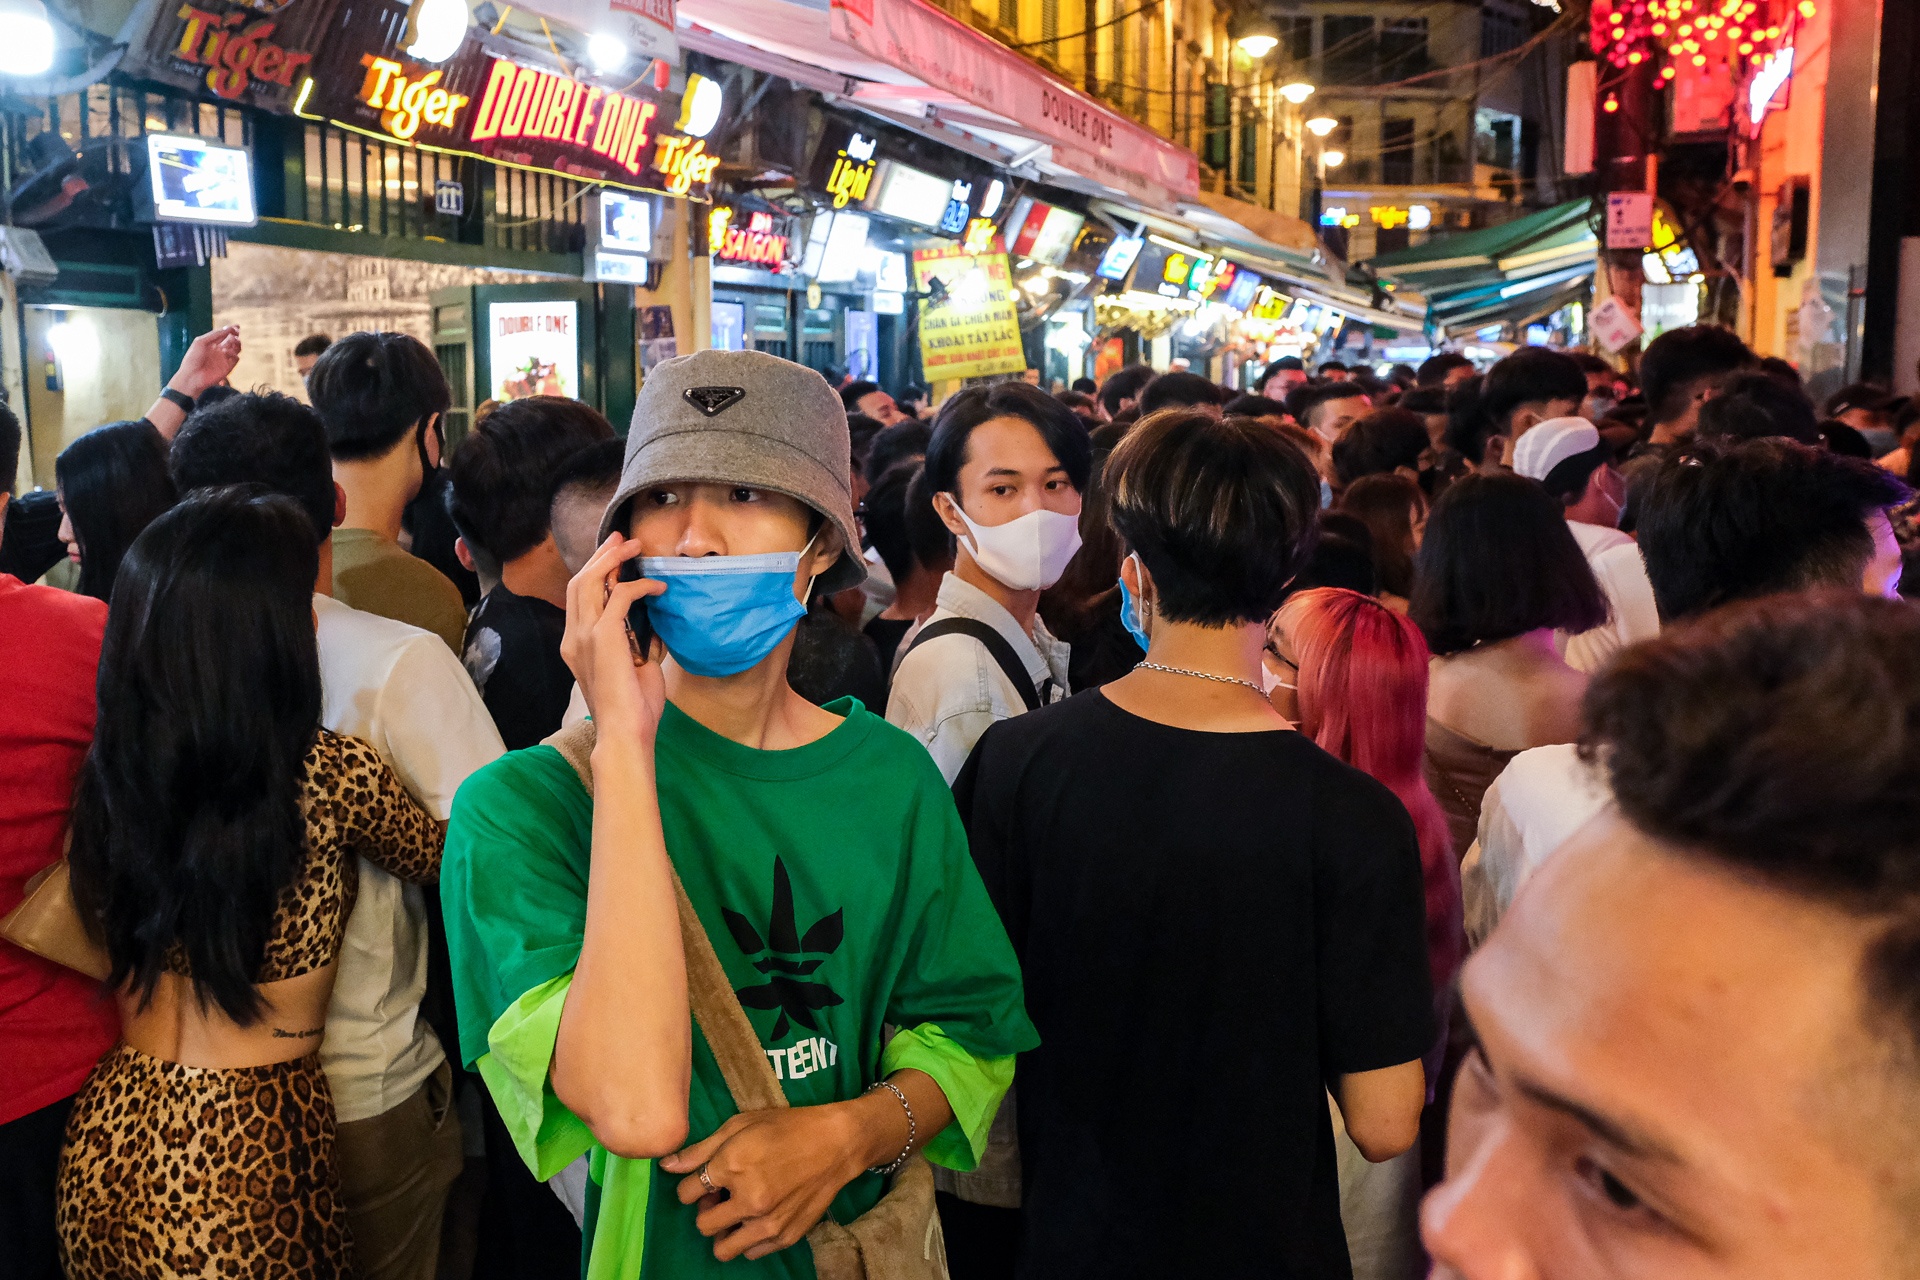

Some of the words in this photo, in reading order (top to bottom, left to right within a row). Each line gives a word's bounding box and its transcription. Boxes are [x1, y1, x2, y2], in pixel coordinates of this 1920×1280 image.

[177, 5, 312, 98] Tiger
[363, 56, 469, 139] Tiger
[470, 58, 602, 147] DOUBLE
[592, 92, 657, 176] ONE
[1042, 90, 1087, 137] DOUBLE
[1092, 117, 1112, 148] ONE
[657, 135, 720, 196] Tiger
